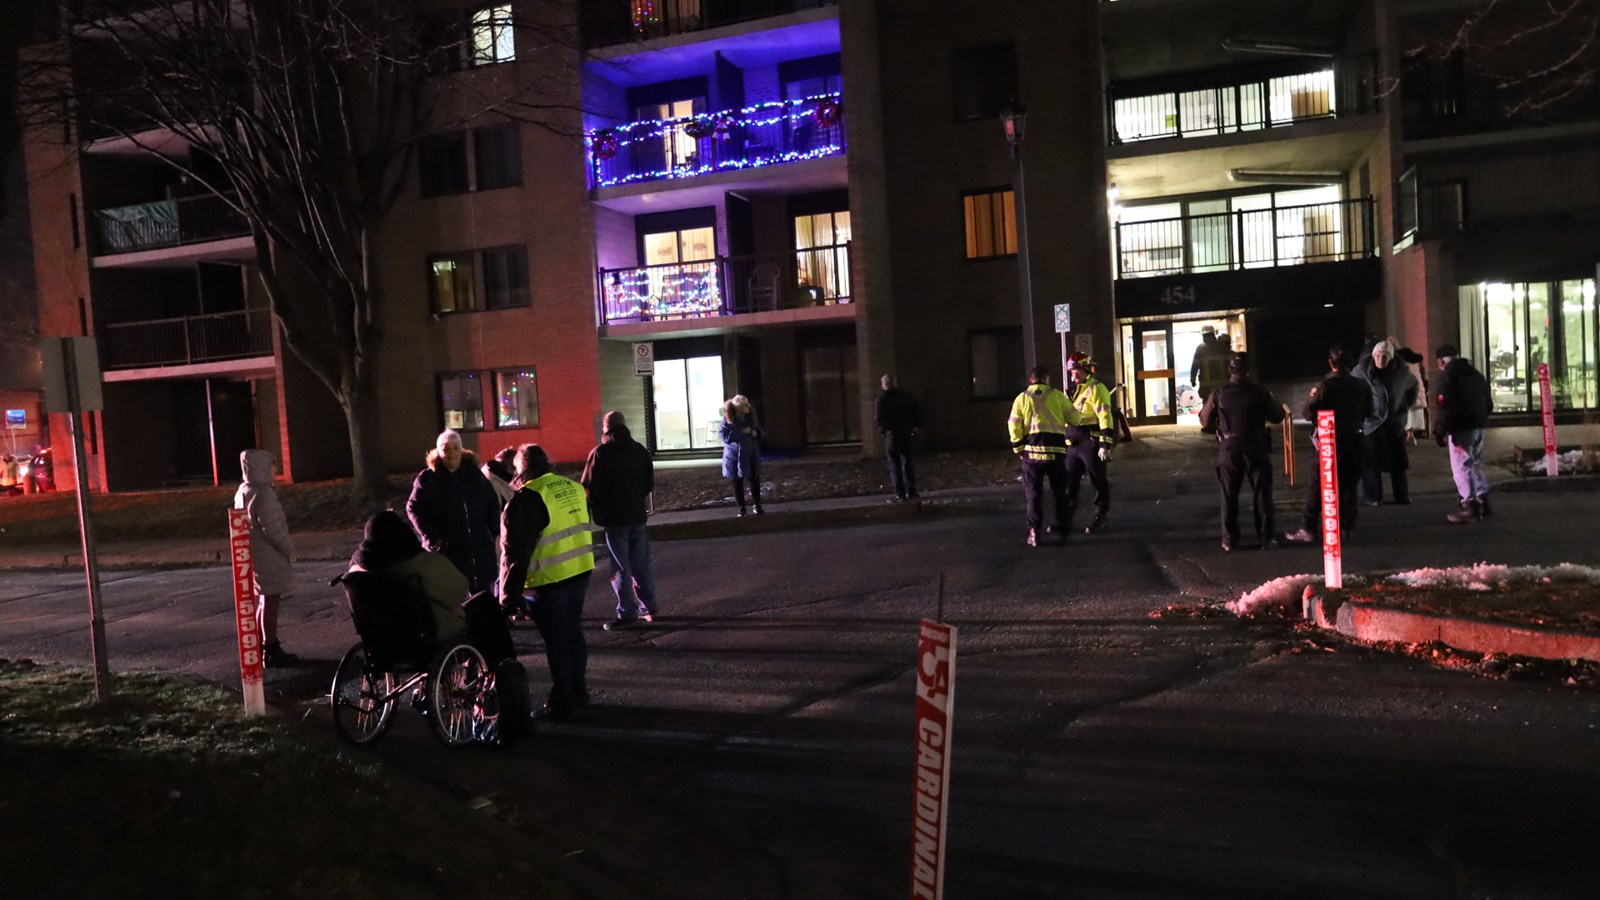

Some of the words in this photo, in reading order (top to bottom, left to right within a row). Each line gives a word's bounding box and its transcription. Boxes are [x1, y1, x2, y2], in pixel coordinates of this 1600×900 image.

[1160, 284, 1196, 304] 454
[1321, 445, 1338, 545] 371-5598
[234, 547, 258, 666] 371-5598
[914, 716, 944, 900] CARDINAL
